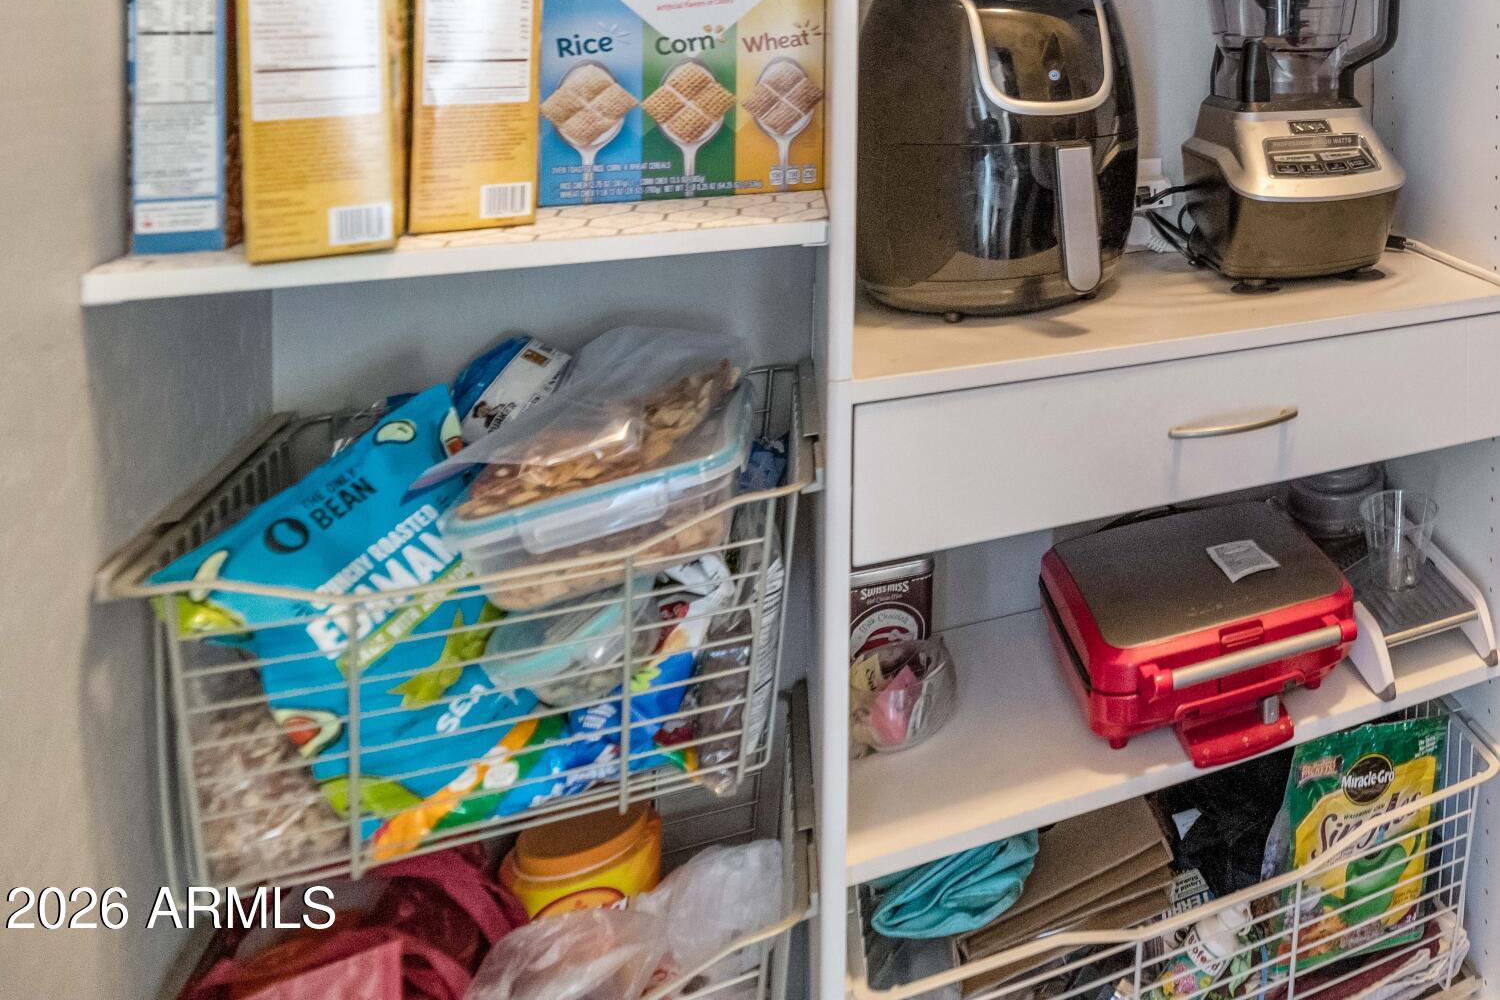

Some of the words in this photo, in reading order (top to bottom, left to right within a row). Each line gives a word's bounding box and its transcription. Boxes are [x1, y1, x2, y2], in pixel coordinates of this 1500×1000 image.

[556, 33, 614, 57] Rice
[654, 33, 716, 56] Corn
[741, 29, 811, 53] Wheat
[308, 476, 379, 531] BEAN
[366, 502, 440, 562] ROASTED
[1341, 769, 1377, 791] Miracle
[1377, 768, 1396, 783] Gro
